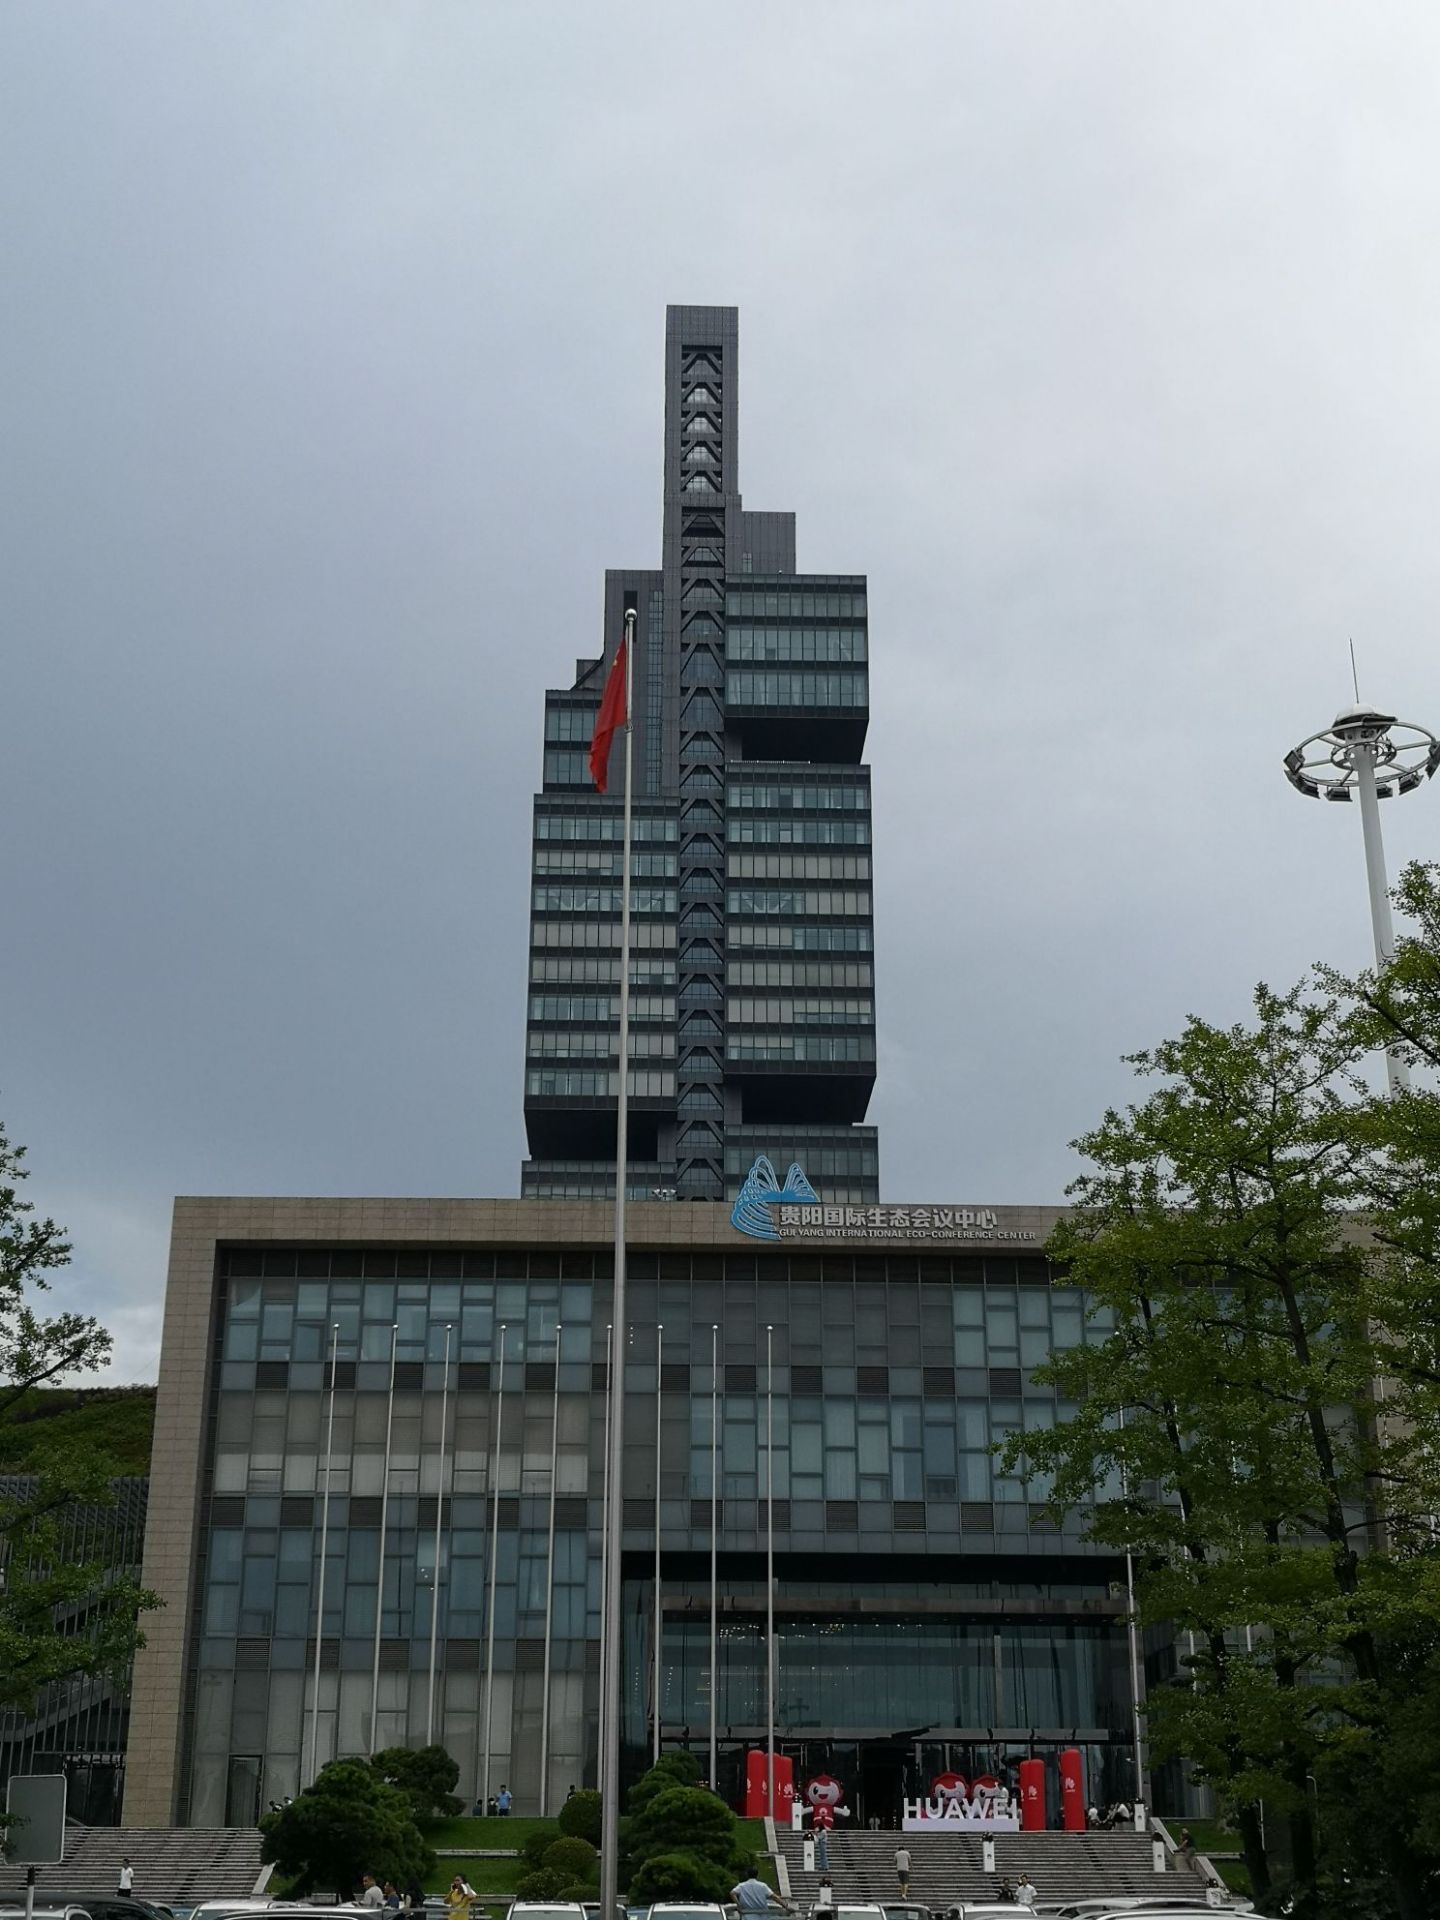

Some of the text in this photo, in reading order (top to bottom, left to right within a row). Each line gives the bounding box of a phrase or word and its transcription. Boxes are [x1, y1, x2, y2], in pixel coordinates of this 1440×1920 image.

[780, 1206, 997, 1230] 贵阳国际生态会议中心
[826, 1229, 905, 1238] INTERNATIONAL
[906, 1230, 993, 1239] ECO-CONFERENCE
[997, 1231, 1036, 1240] CENTER
[903, 1797, 1018, 1820] HUAWEI
